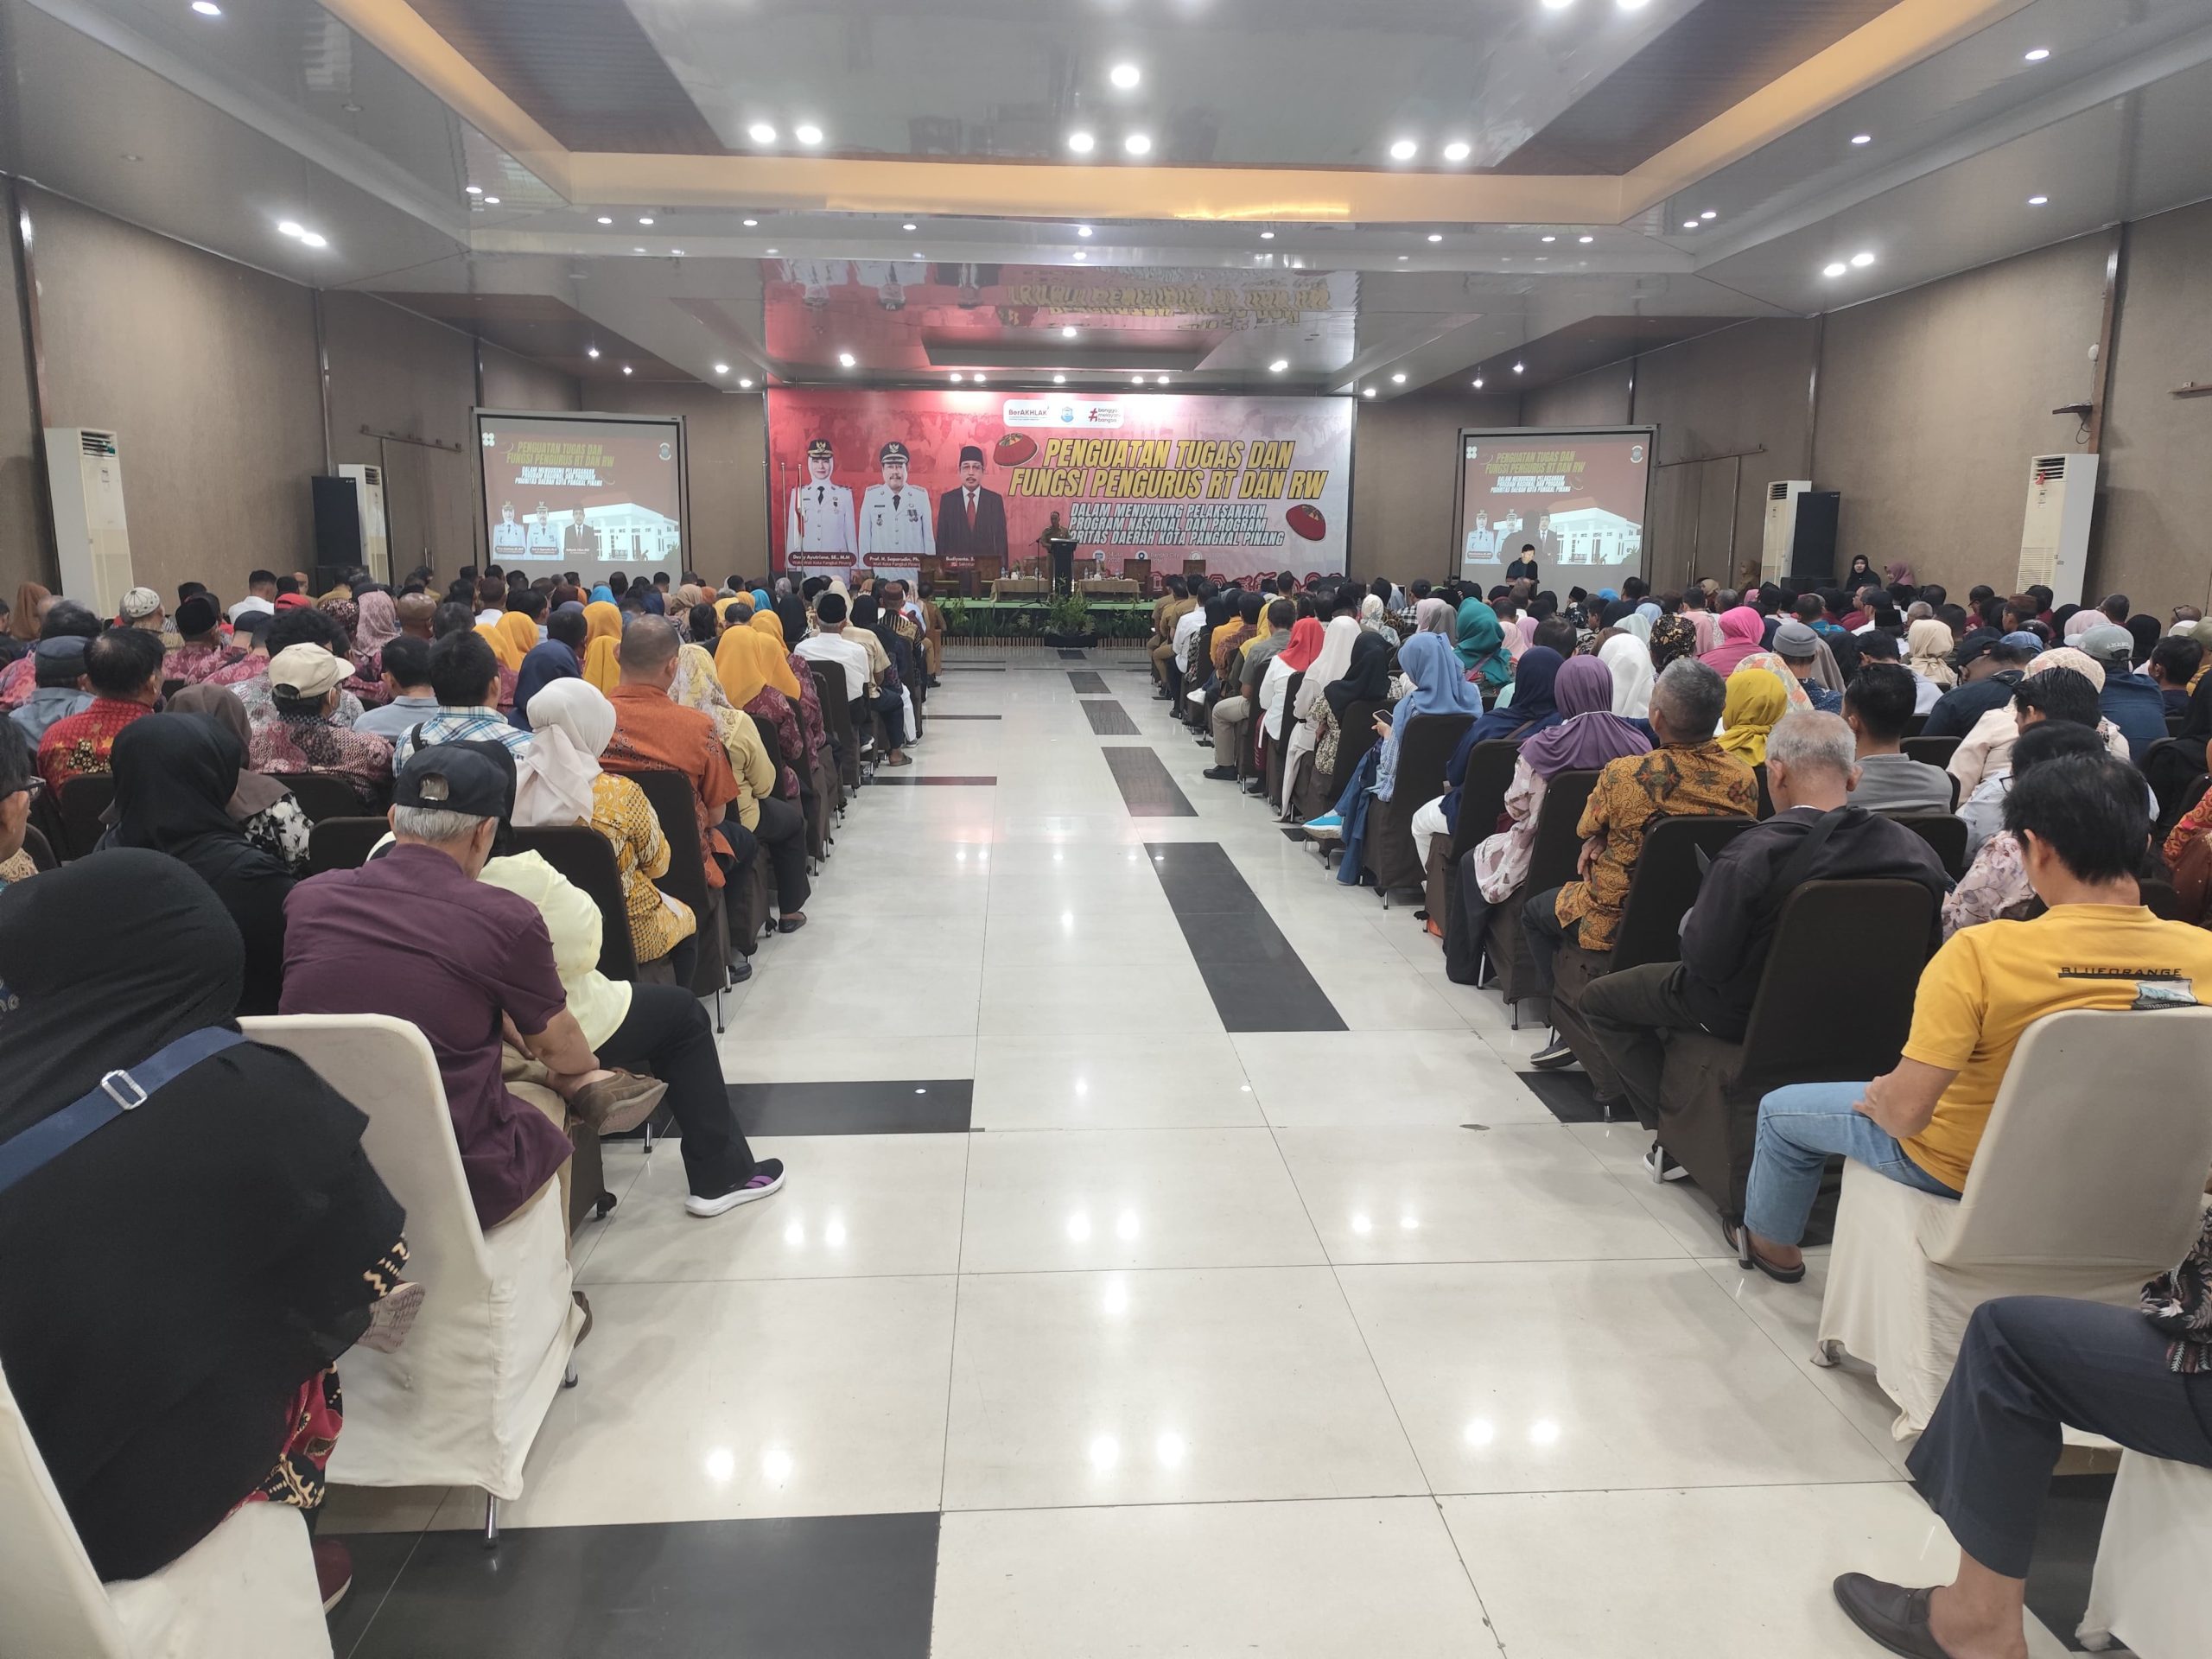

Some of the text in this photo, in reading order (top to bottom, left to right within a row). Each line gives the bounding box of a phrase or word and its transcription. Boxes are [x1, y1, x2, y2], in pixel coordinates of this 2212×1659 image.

[518, 442, 603, 455] PENGUATAN TUGAS DAN
[1042, 438, 1296, 469] PENGUATAN TUGAS DAN
[506, 452, 534, 464] FUNGSI
[535, 454, 573, 466] PENGURUS
[585, 455, 601, 467] DAN
[1496, 451, 1576, 463] PENGUATAN TUGAS DAN
[1485, 463, 1510, 474] FUNGSI
[1510, 462, 1547, 474] PENGURUS
[1557, 461, 1573, 473] DAN
[1573, 461, 1586, 473] RW
[1008, 467, 1329, 499] FUNGSI PENGURUS RT DAN RW
[1071, 502, 1267, 518] DALAM MENDUKUNG PELAKSANAAN
[1068, 517, 1268, 532] PROGRAM NASIONAL DAN PROGRAM
[1069, 531, 1285, 546] ORITAS DAERAH KOTA PANGKAL PINANG
[2061, 967, 2183, 977] BLUEORANGE
